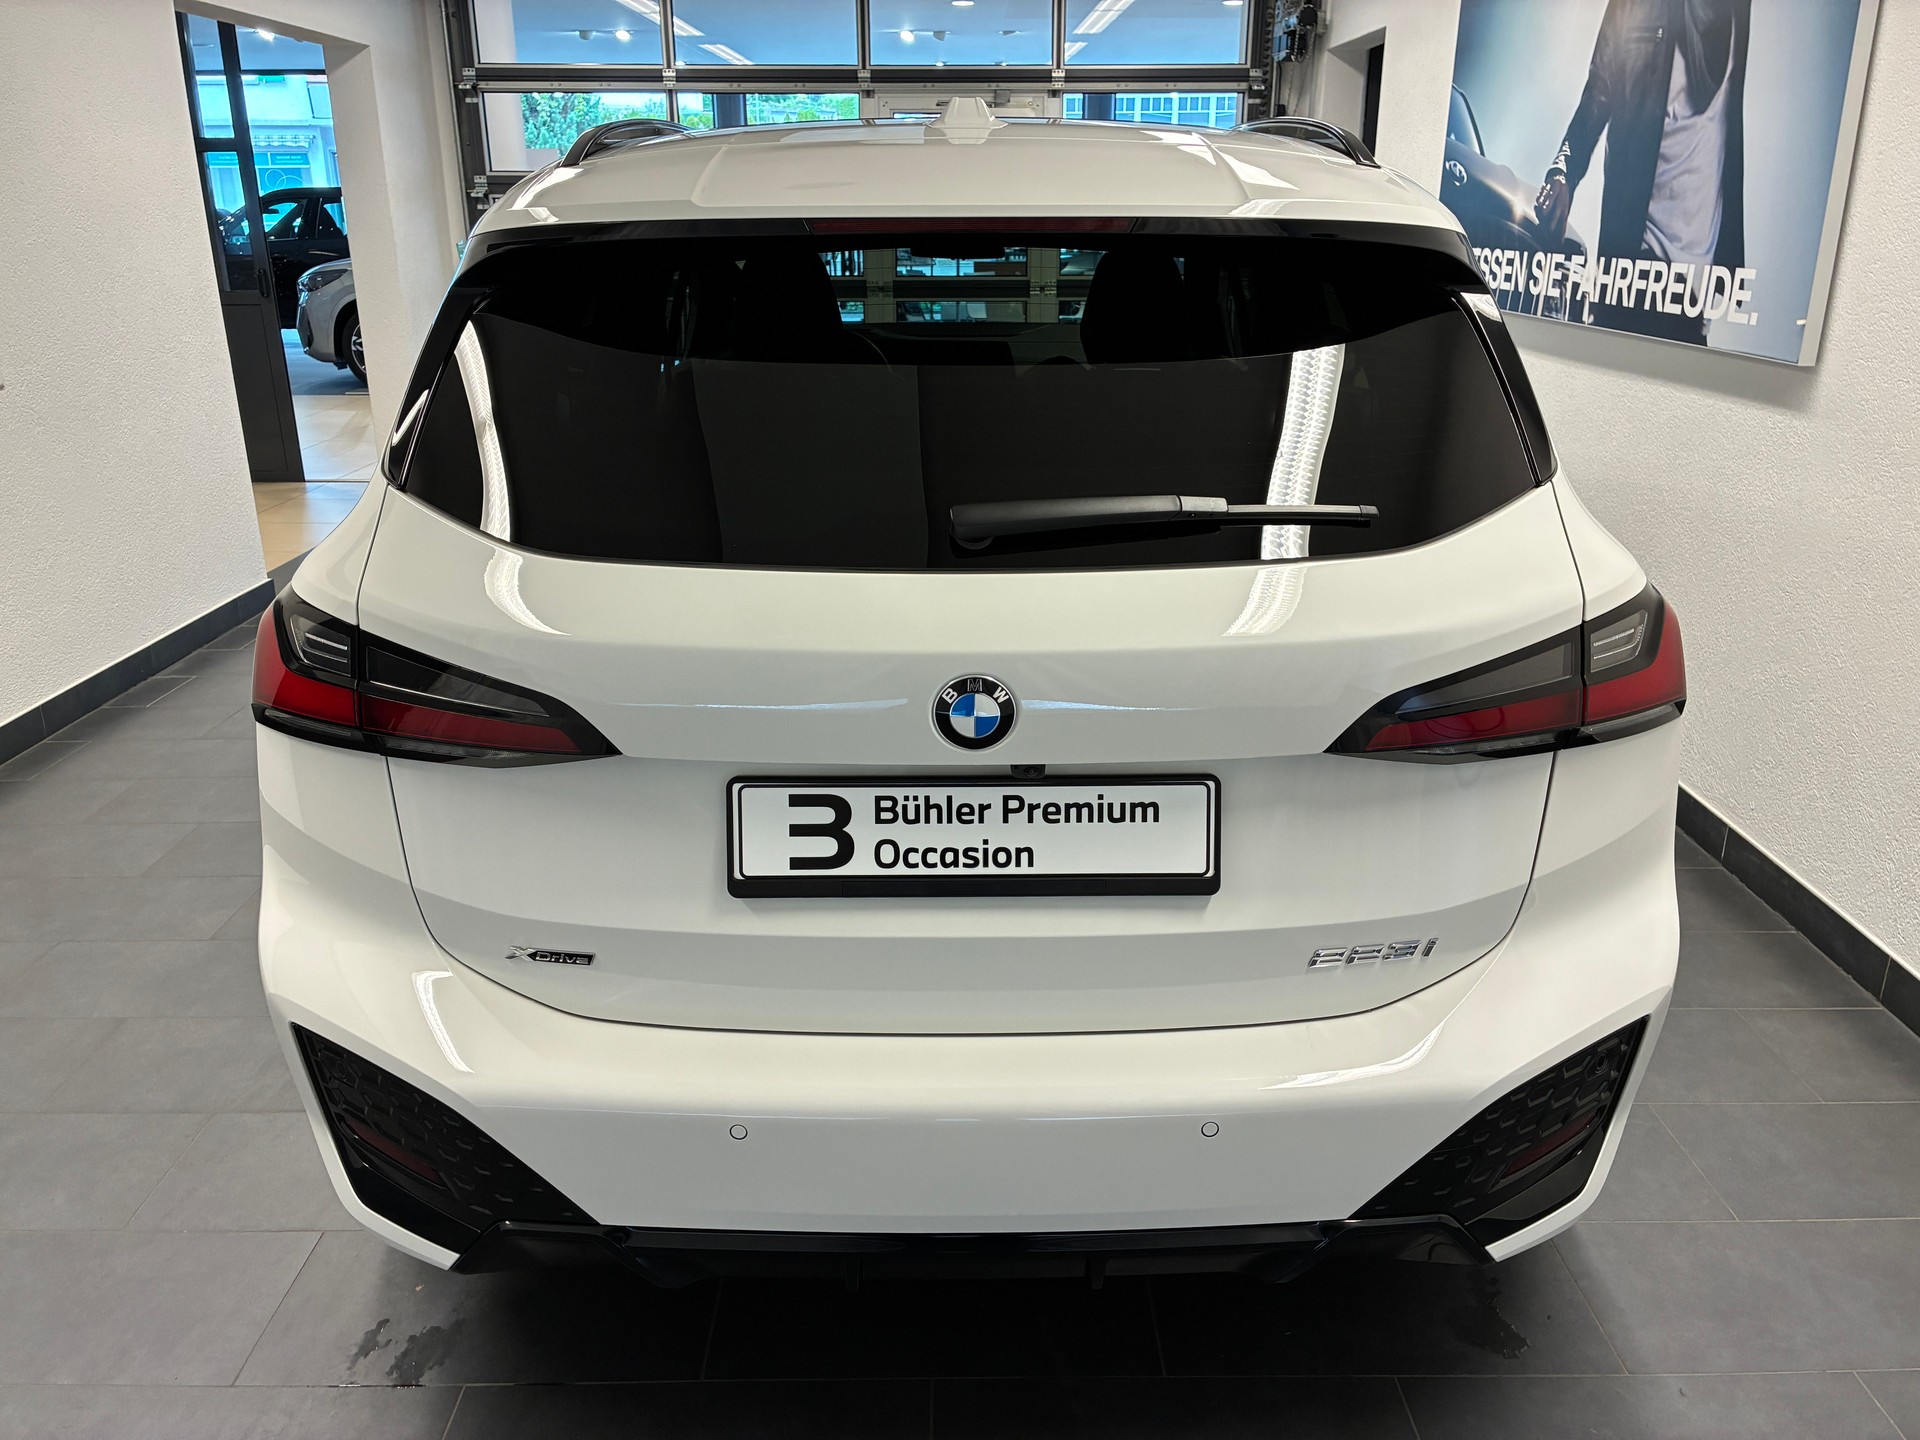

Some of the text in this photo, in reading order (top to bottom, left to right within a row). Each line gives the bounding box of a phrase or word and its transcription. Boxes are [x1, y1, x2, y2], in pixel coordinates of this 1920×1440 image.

[1472, 247, 1757, 326] SSEN SIE FAHRFREUDE.
[941, 678, 1010, 704] BMW
[874, 794, 1160, 825] Bühler Premium
[873, 838, 1035, 869] Occasion
